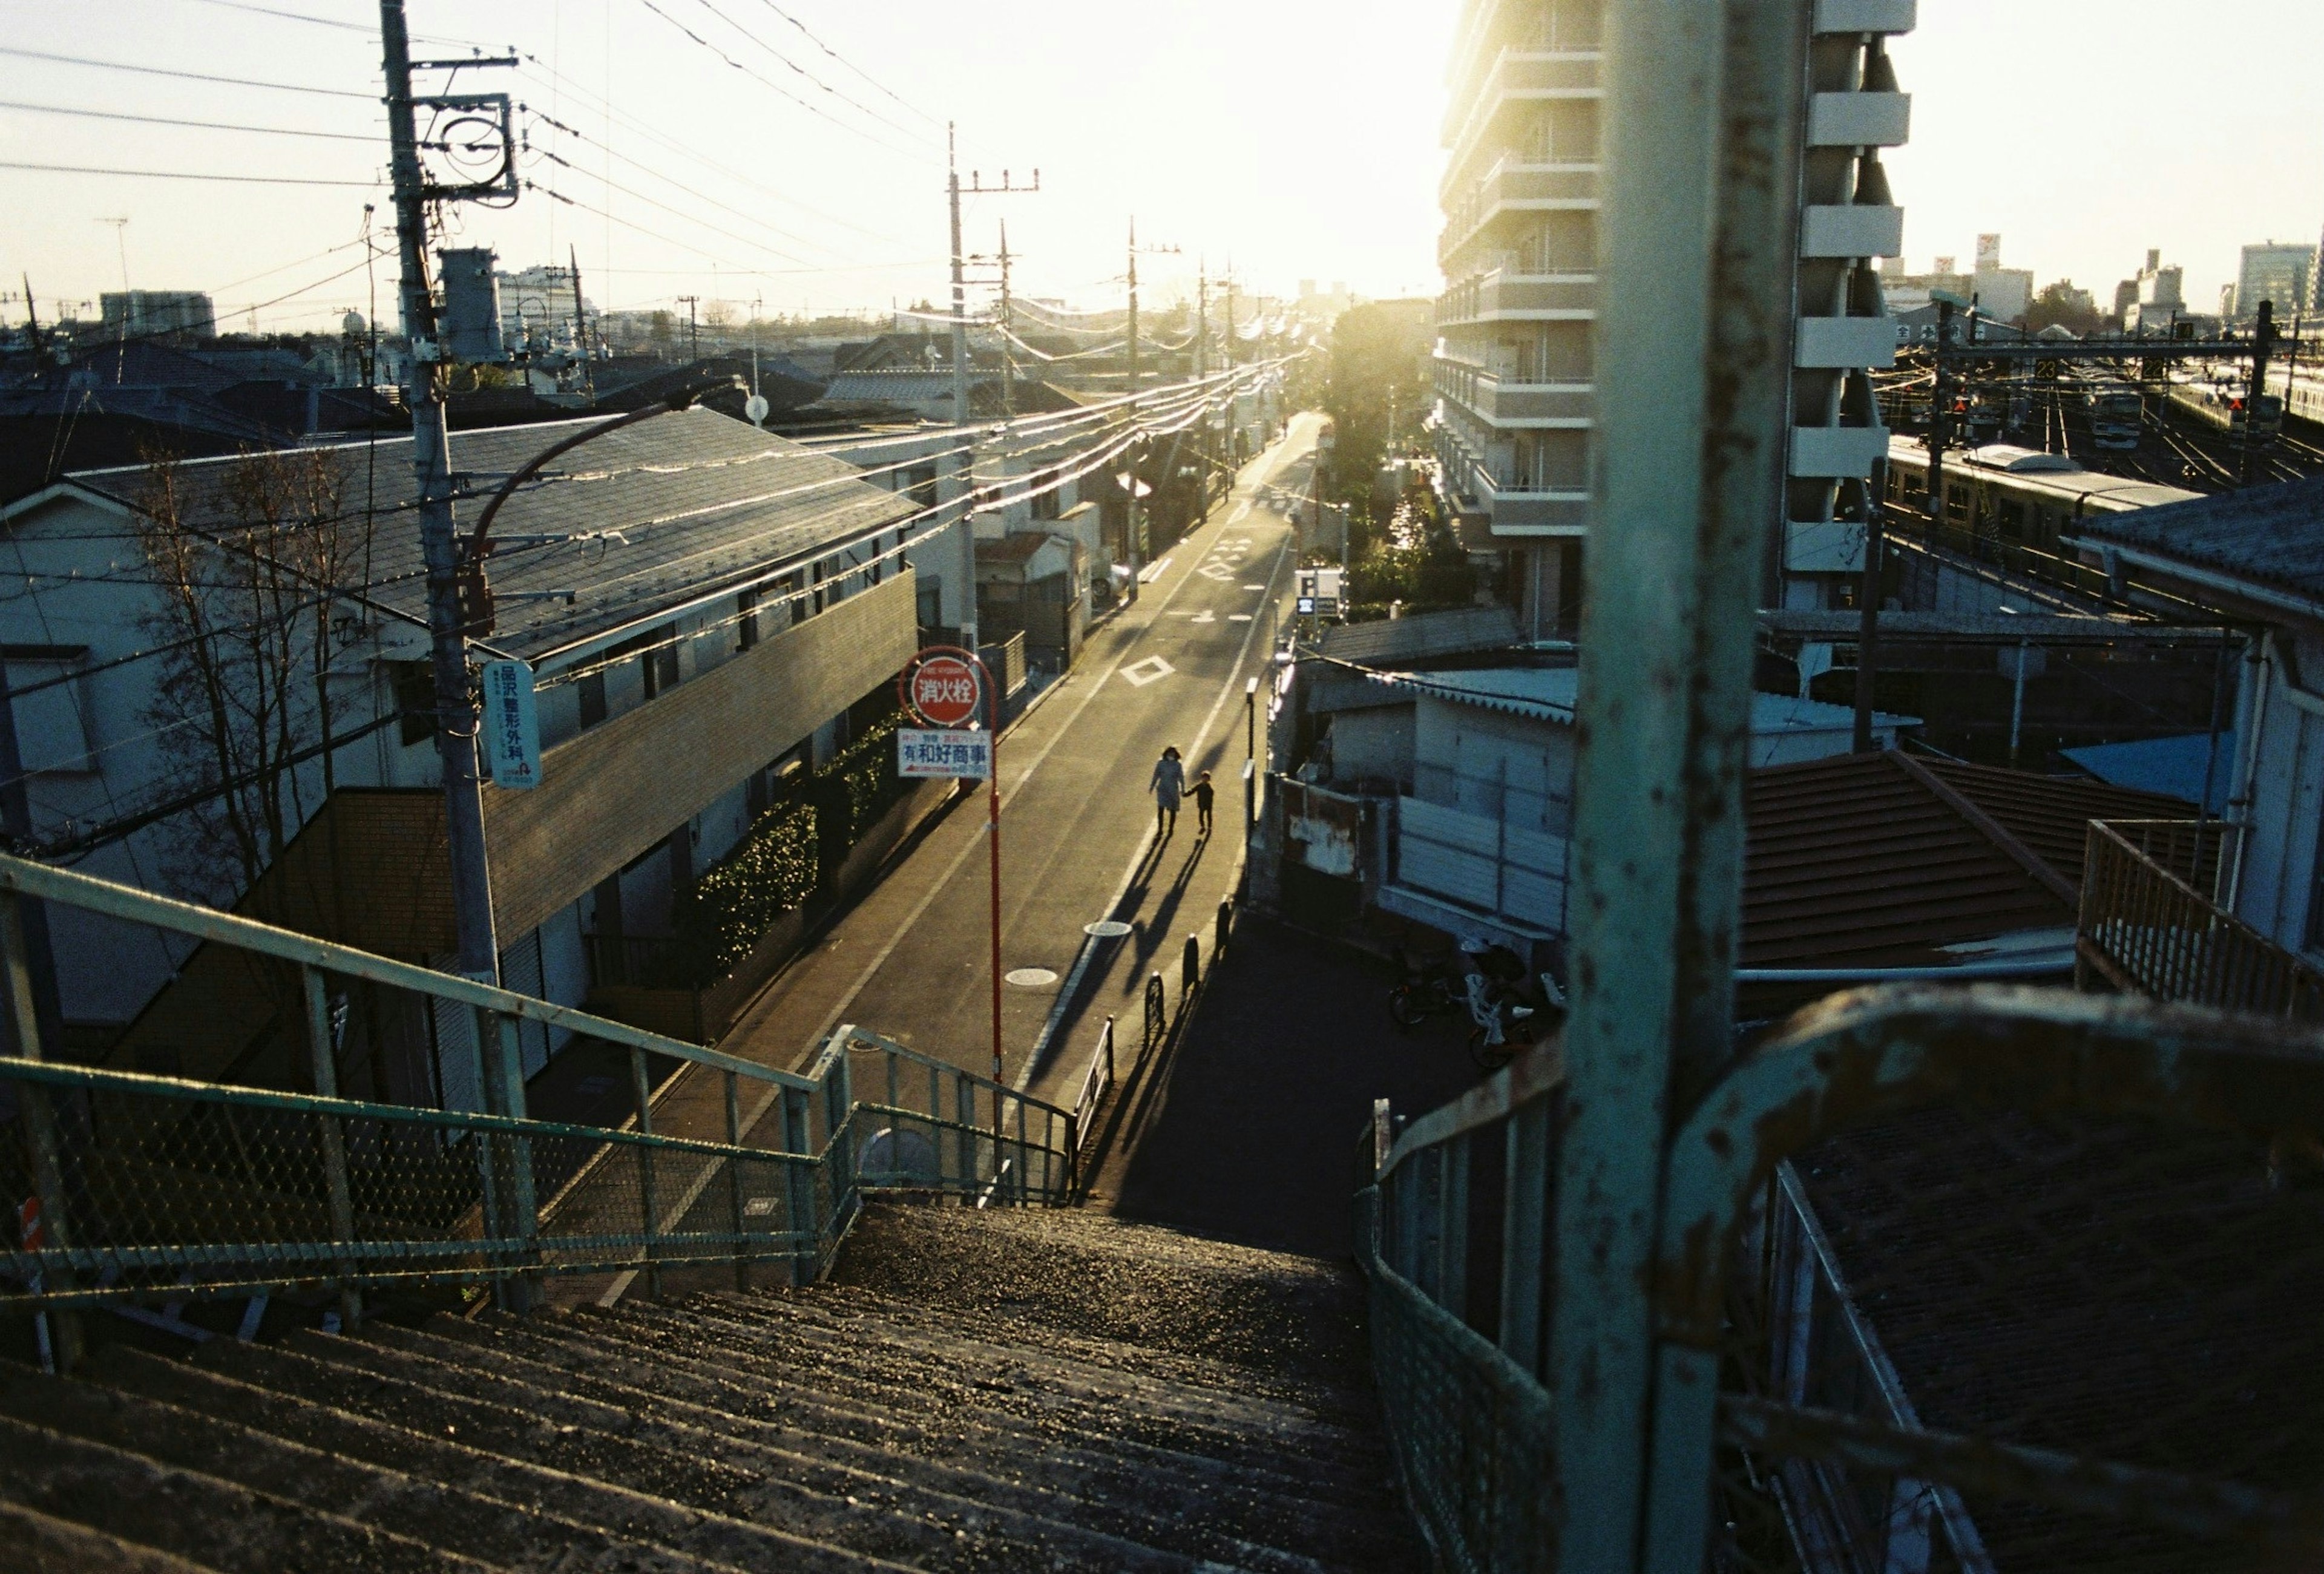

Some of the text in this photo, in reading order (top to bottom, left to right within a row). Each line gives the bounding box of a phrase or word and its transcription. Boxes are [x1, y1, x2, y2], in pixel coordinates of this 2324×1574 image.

[2037, 361, 2056, 378] 23
[918, 678, 973, 703] 消火栓
